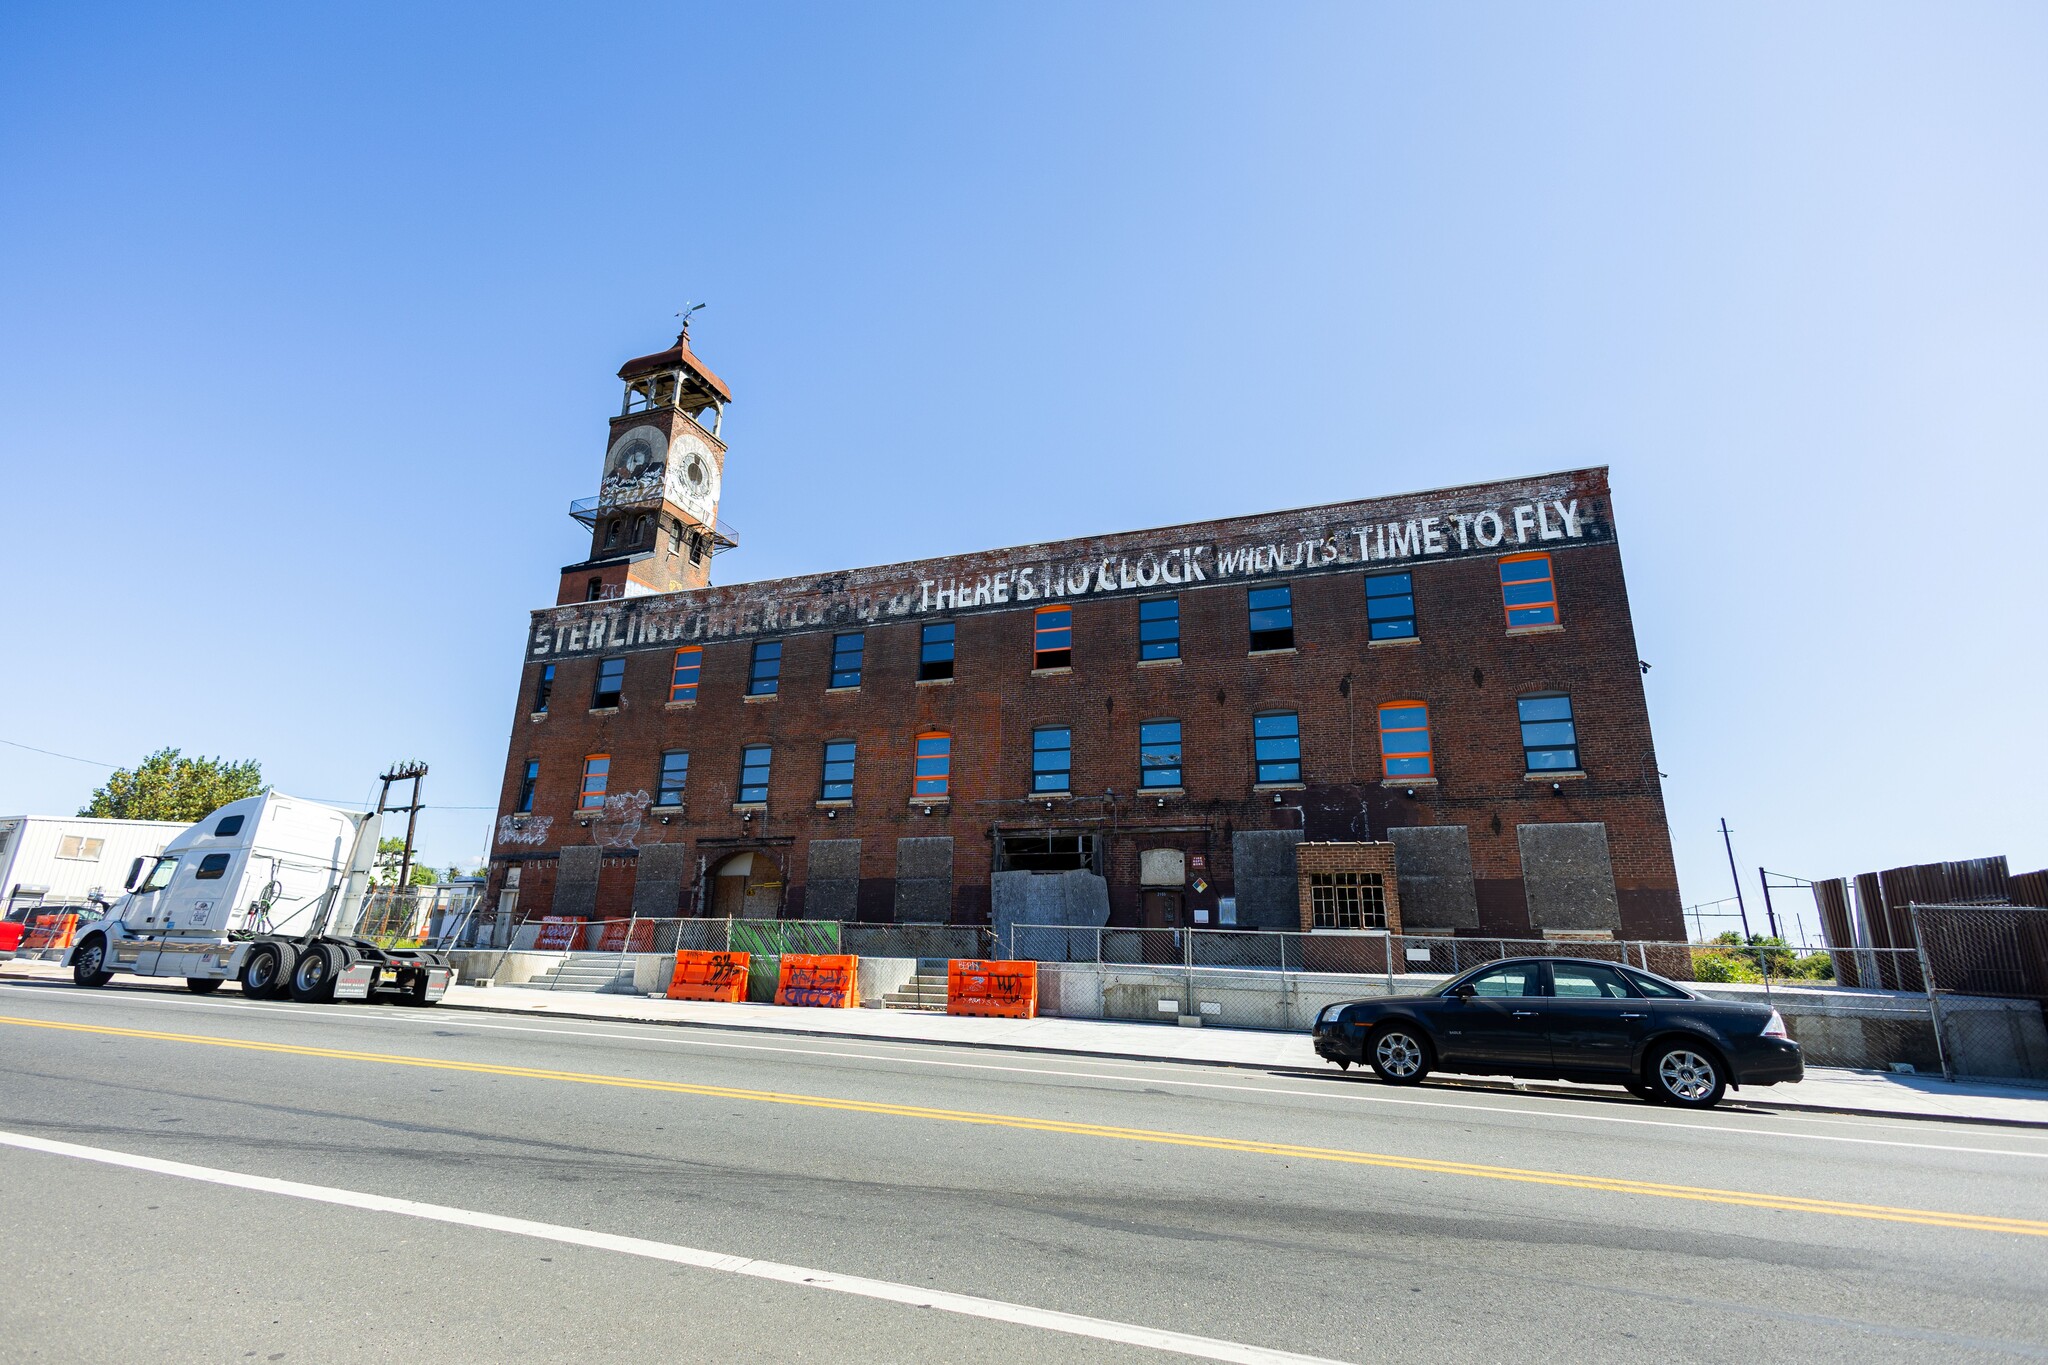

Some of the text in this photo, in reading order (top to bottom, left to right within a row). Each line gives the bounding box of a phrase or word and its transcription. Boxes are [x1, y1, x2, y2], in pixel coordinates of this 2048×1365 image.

[919, 567, 1036, 612] THERE'S
[1218, 543, 1286, 575] WHEN
[1351, 516, 1447, 561] TIME
[1450, 509, 1504, 550] TO
[1513, 499, 1579, 544] FLY
